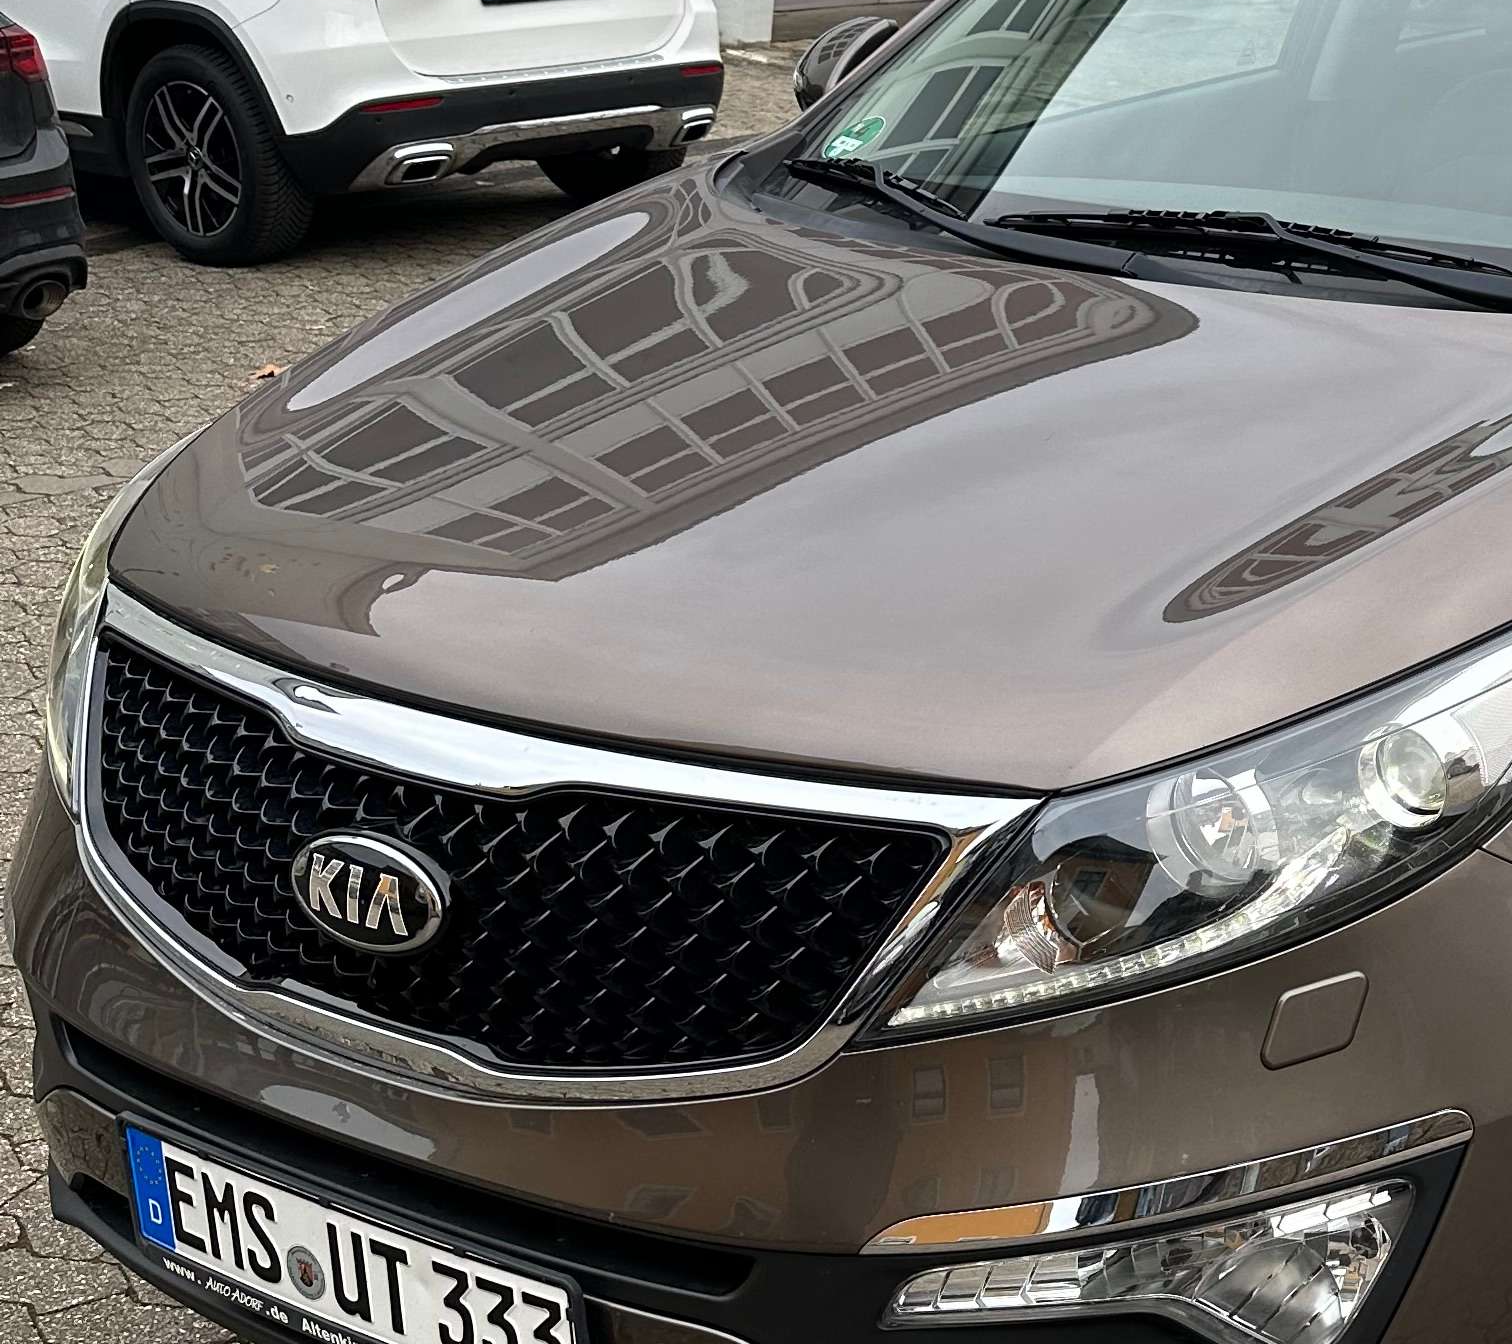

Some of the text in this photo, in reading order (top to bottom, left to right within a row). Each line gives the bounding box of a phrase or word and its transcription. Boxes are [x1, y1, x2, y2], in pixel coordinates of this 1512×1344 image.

[309, 853, 409, 936] KIA
[148, 1198, 163, 1225] D
[164, 1155, 282, 1284] EMS
[327, 1222, 409, 1336] UT
